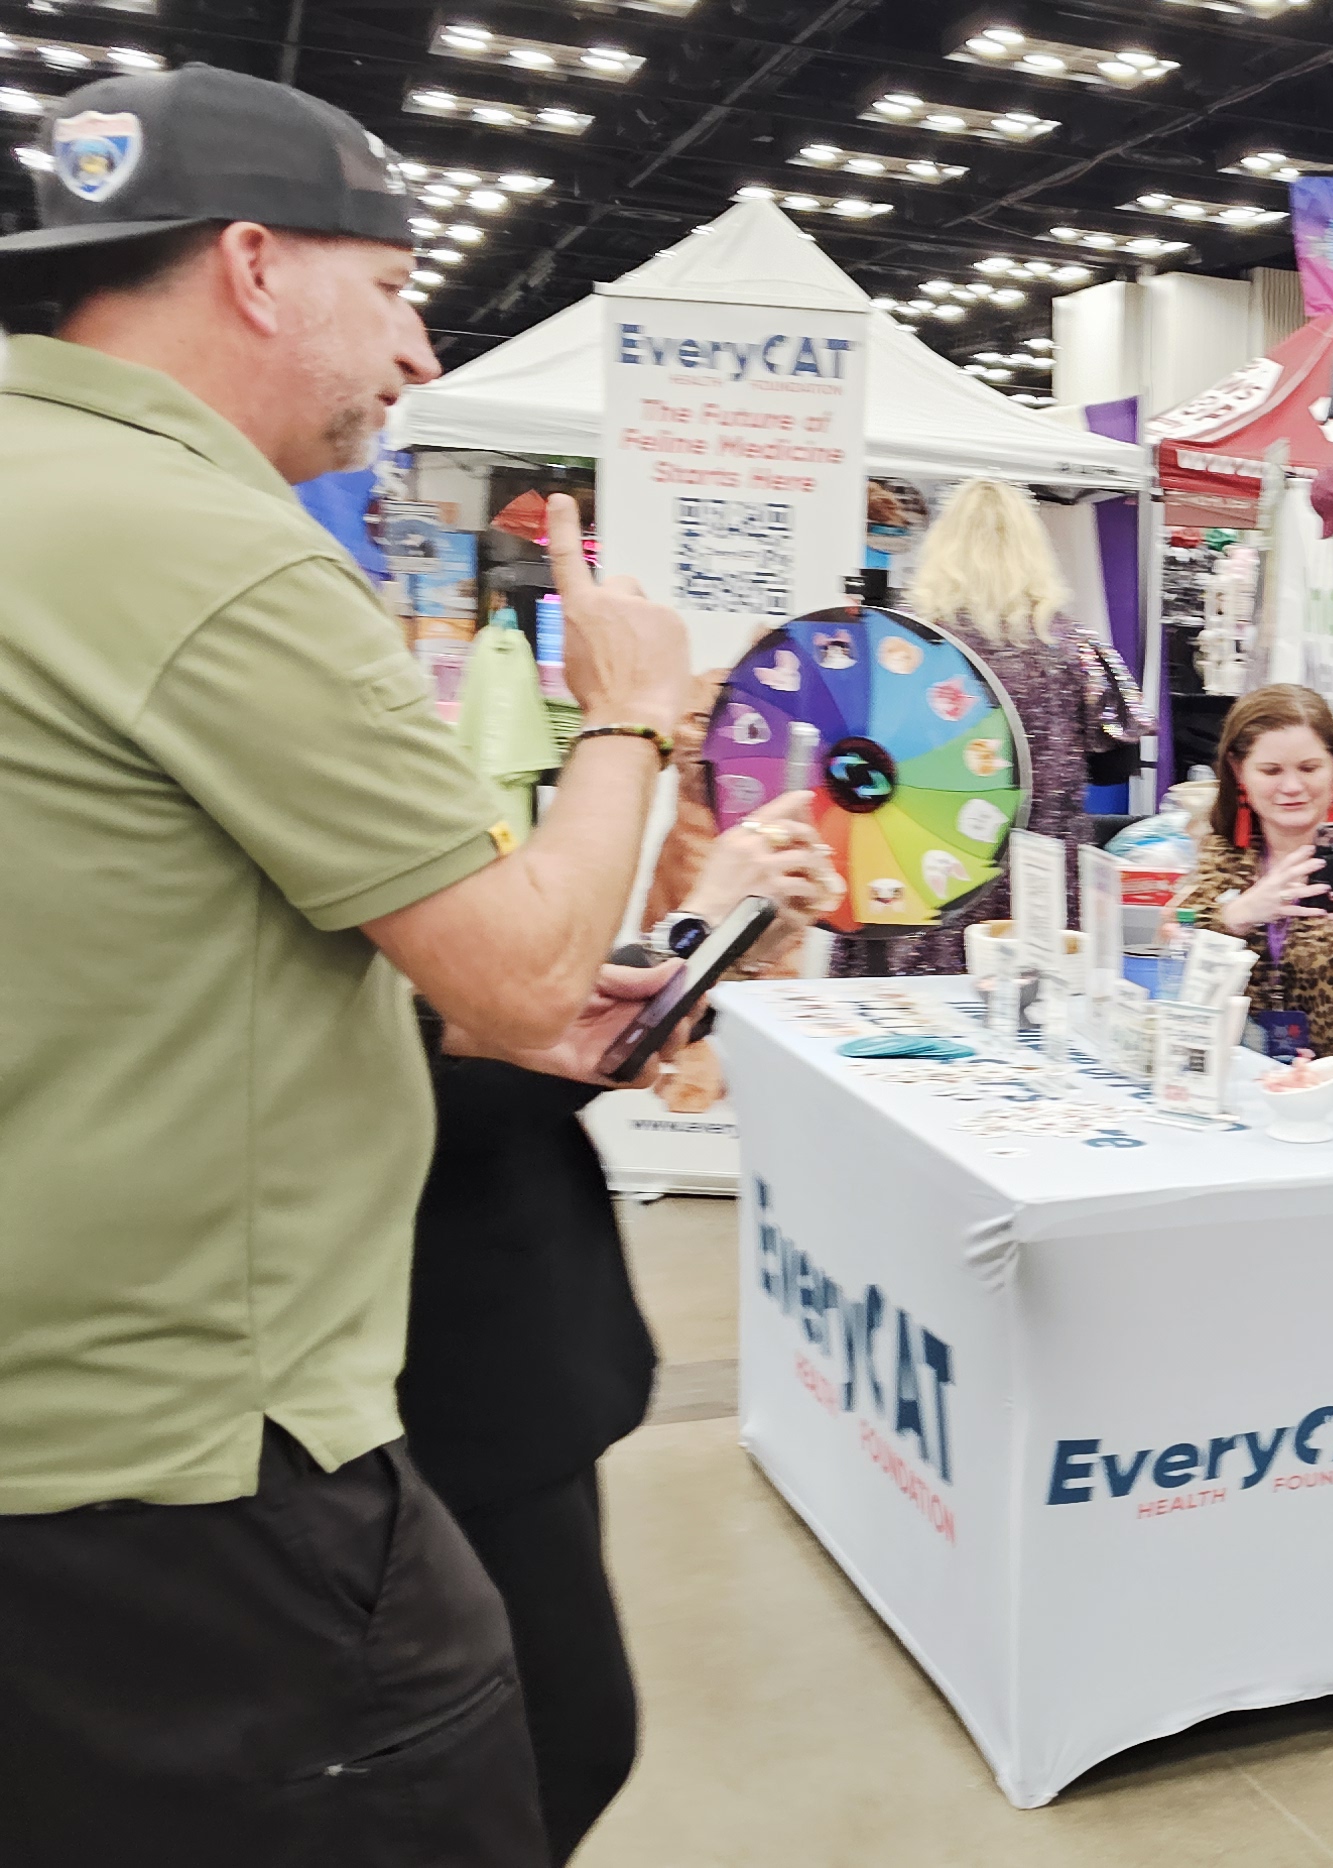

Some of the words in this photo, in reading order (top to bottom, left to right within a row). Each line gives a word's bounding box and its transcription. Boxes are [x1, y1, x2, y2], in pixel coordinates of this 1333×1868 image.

[616, 322, 856, 382] EveryCAT
[640, 398, 693, 424] The
[701, 402, 796, 431] Future
[620, 427, 707, 455] Feline
[716, 434, 846, 465] Medicine
[653, 460, 741, 488] Starts
[750, 466, 818, 493] Here
[755, 1172, 954, 1485] EveryCAT
[1136, 1488, 1228, 1520] HEALTH
